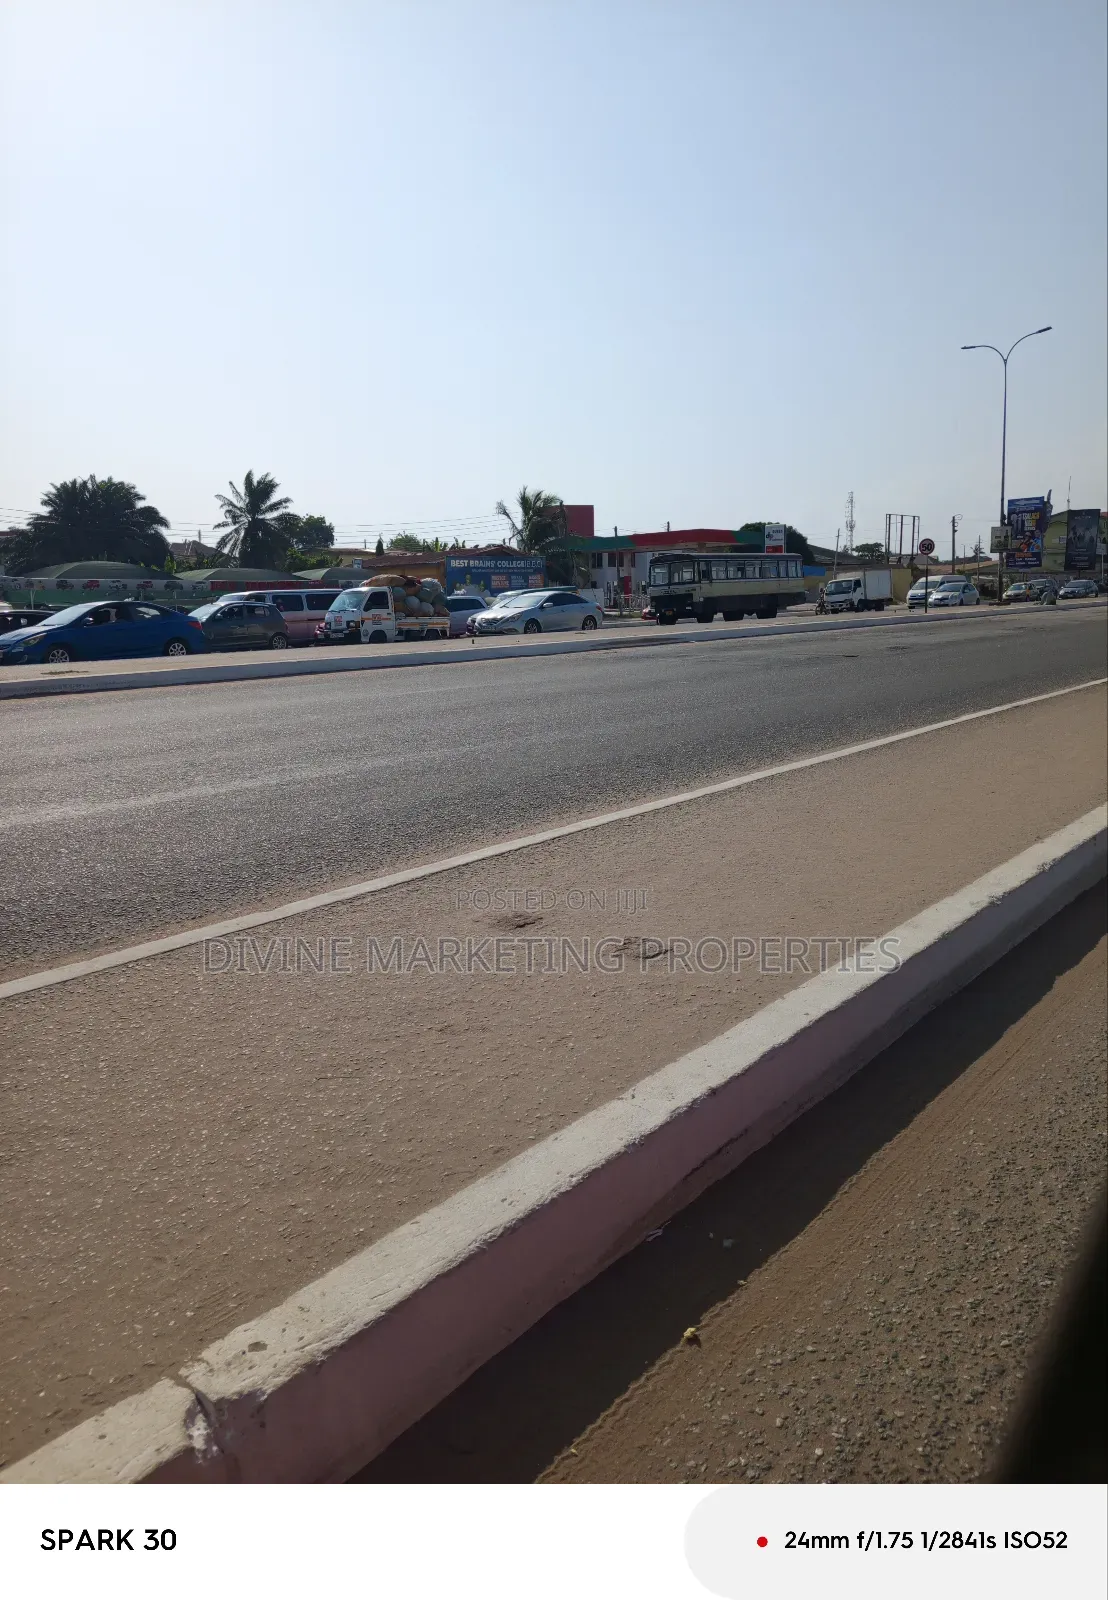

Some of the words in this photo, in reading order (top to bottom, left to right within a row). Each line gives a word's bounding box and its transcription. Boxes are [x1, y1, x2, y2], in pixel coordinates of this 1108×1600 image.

[921, 543, 933, 552] 50
[450, 560, 468, 568] BEST
[497, 560, 525, 568] COLLEGE
